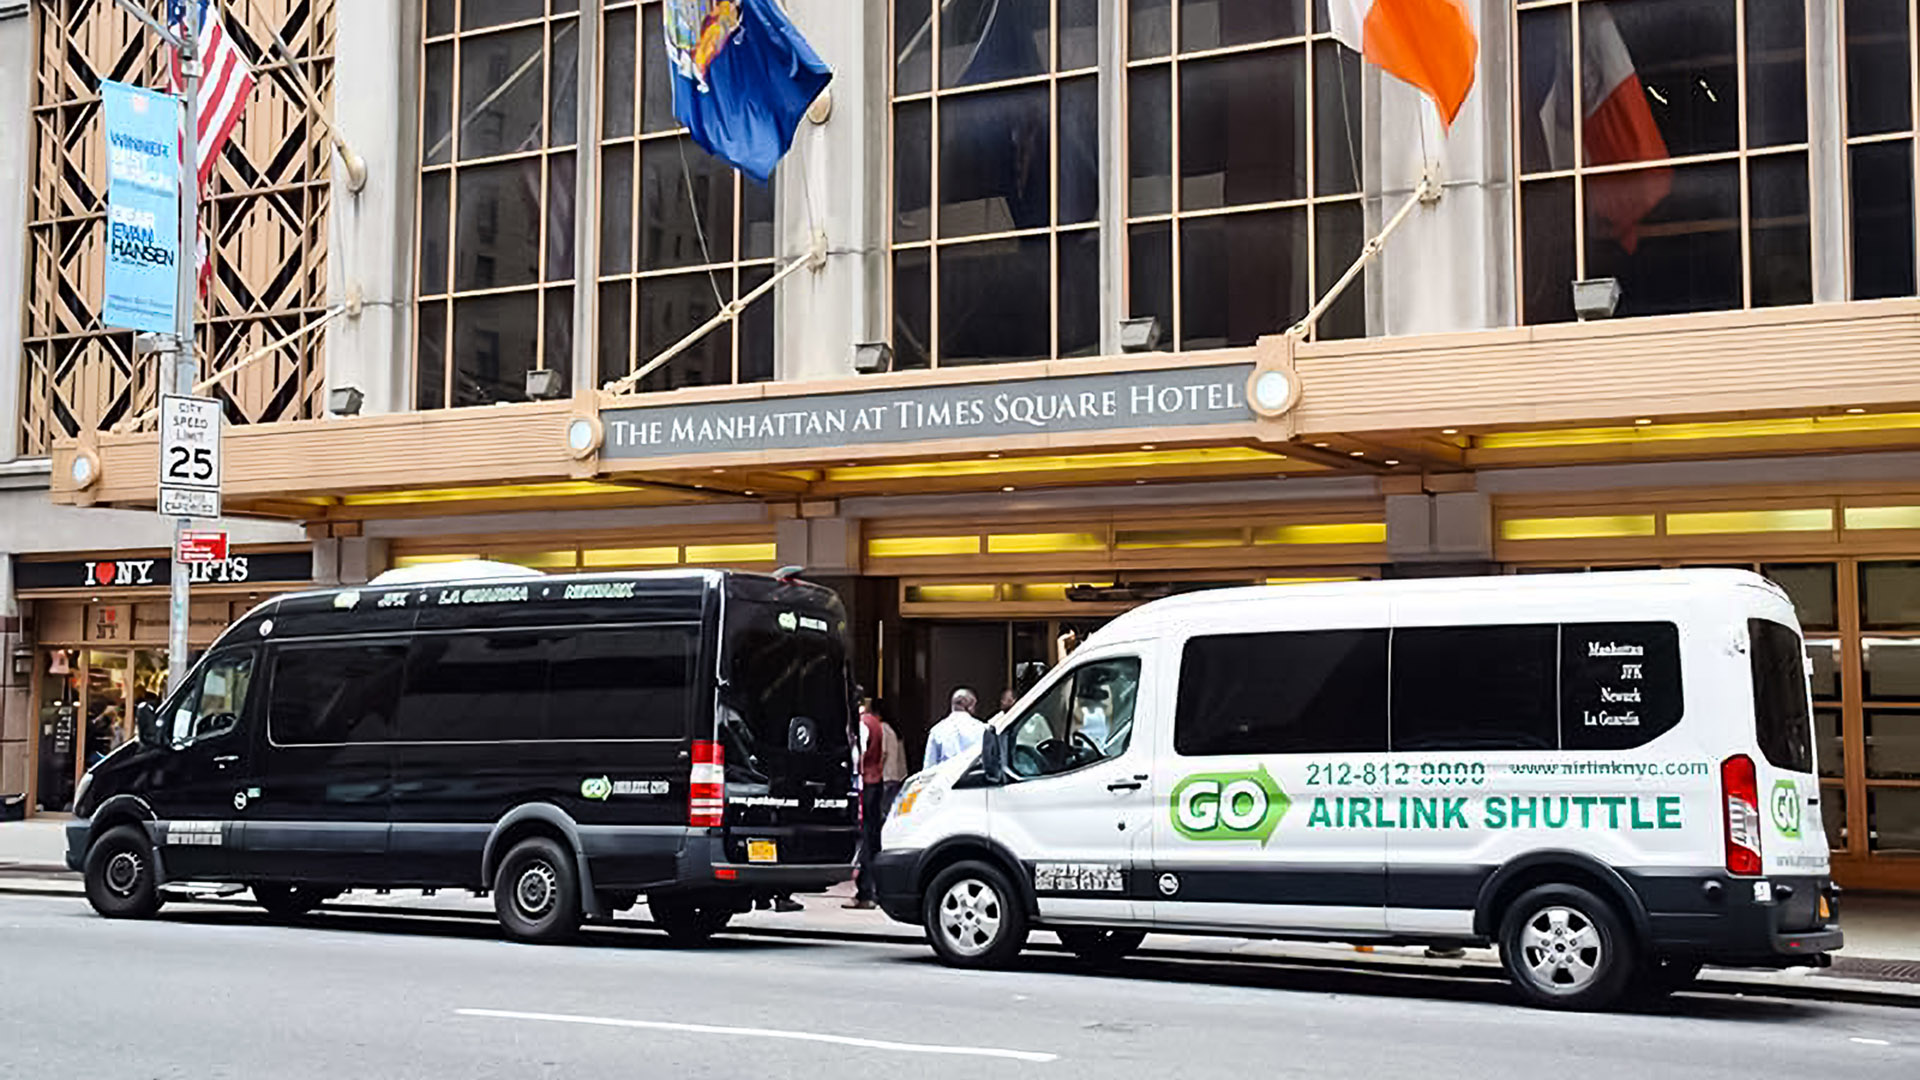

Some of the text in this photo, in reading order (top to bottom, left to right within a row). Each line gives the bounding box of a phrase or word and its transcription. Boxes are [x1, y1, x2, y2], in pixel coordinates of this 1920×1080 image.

[111, 239, 174, 266] HANSEN
[172, 416, 209, 430] SPEED
[611, 383, 1244, 446] THE MANHATTAN AT TIMES SQUARE HOTEL
[168, 445, 213, 481] 25
[188, 557, 249, 583] IFTS
[1583, 710, 1597, 726] La
[1305, 760, 1709, 786] 212-8129000 wwwairlinknyc.com
[1177, 779, 1270, 833] GO
[1306, 796, 1683, 830] AIRLINK SHUTTLE
